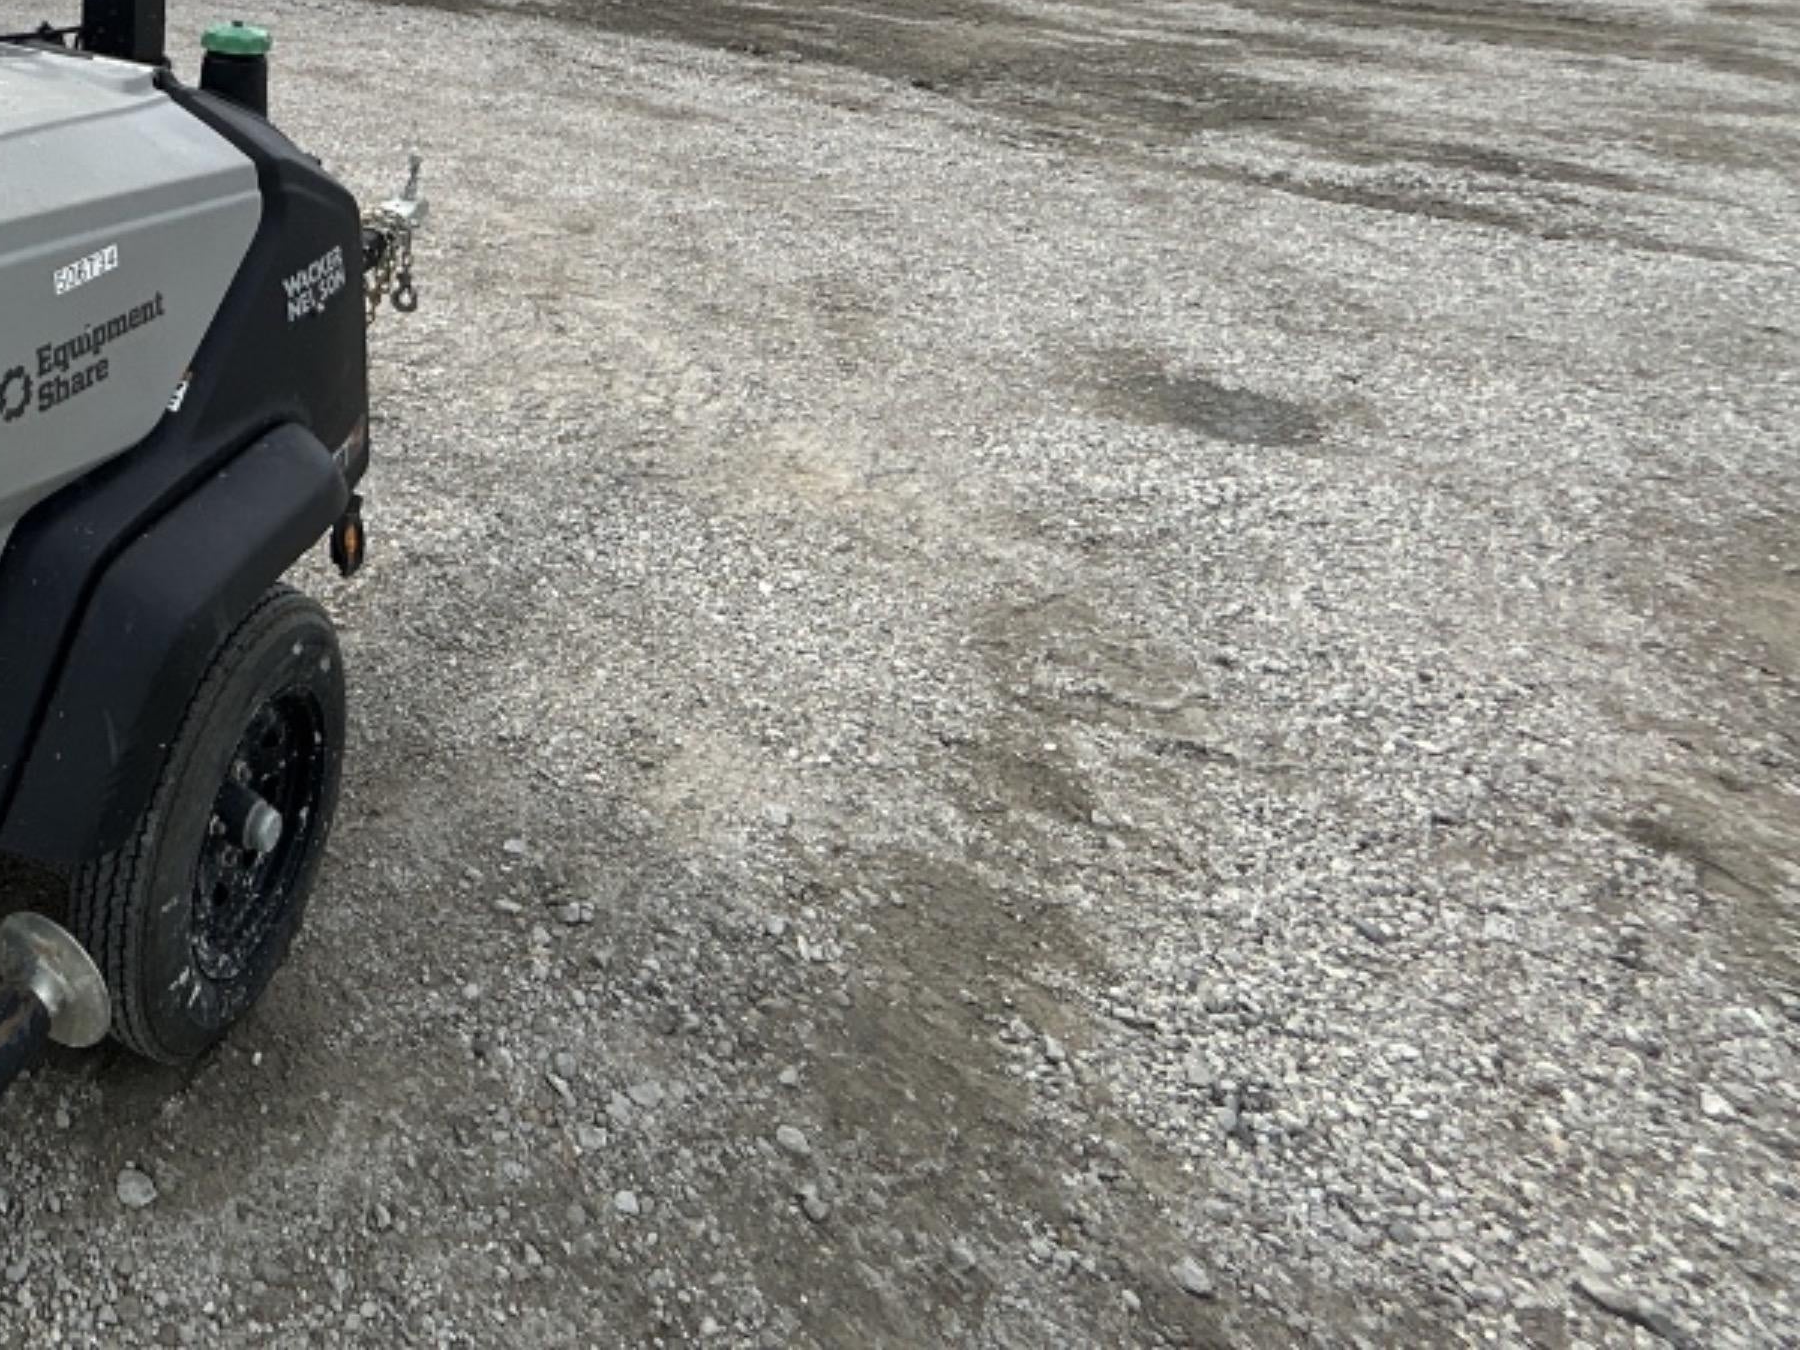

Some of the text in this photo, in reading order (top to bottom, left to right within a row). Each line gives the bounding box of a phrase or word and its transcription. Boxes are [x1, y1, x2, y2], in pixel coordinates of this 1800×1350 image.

[287, 268, 346, 322] NESON
[36, 290, 166, 379] Equipment
[37, 357, 110, 413] Share
